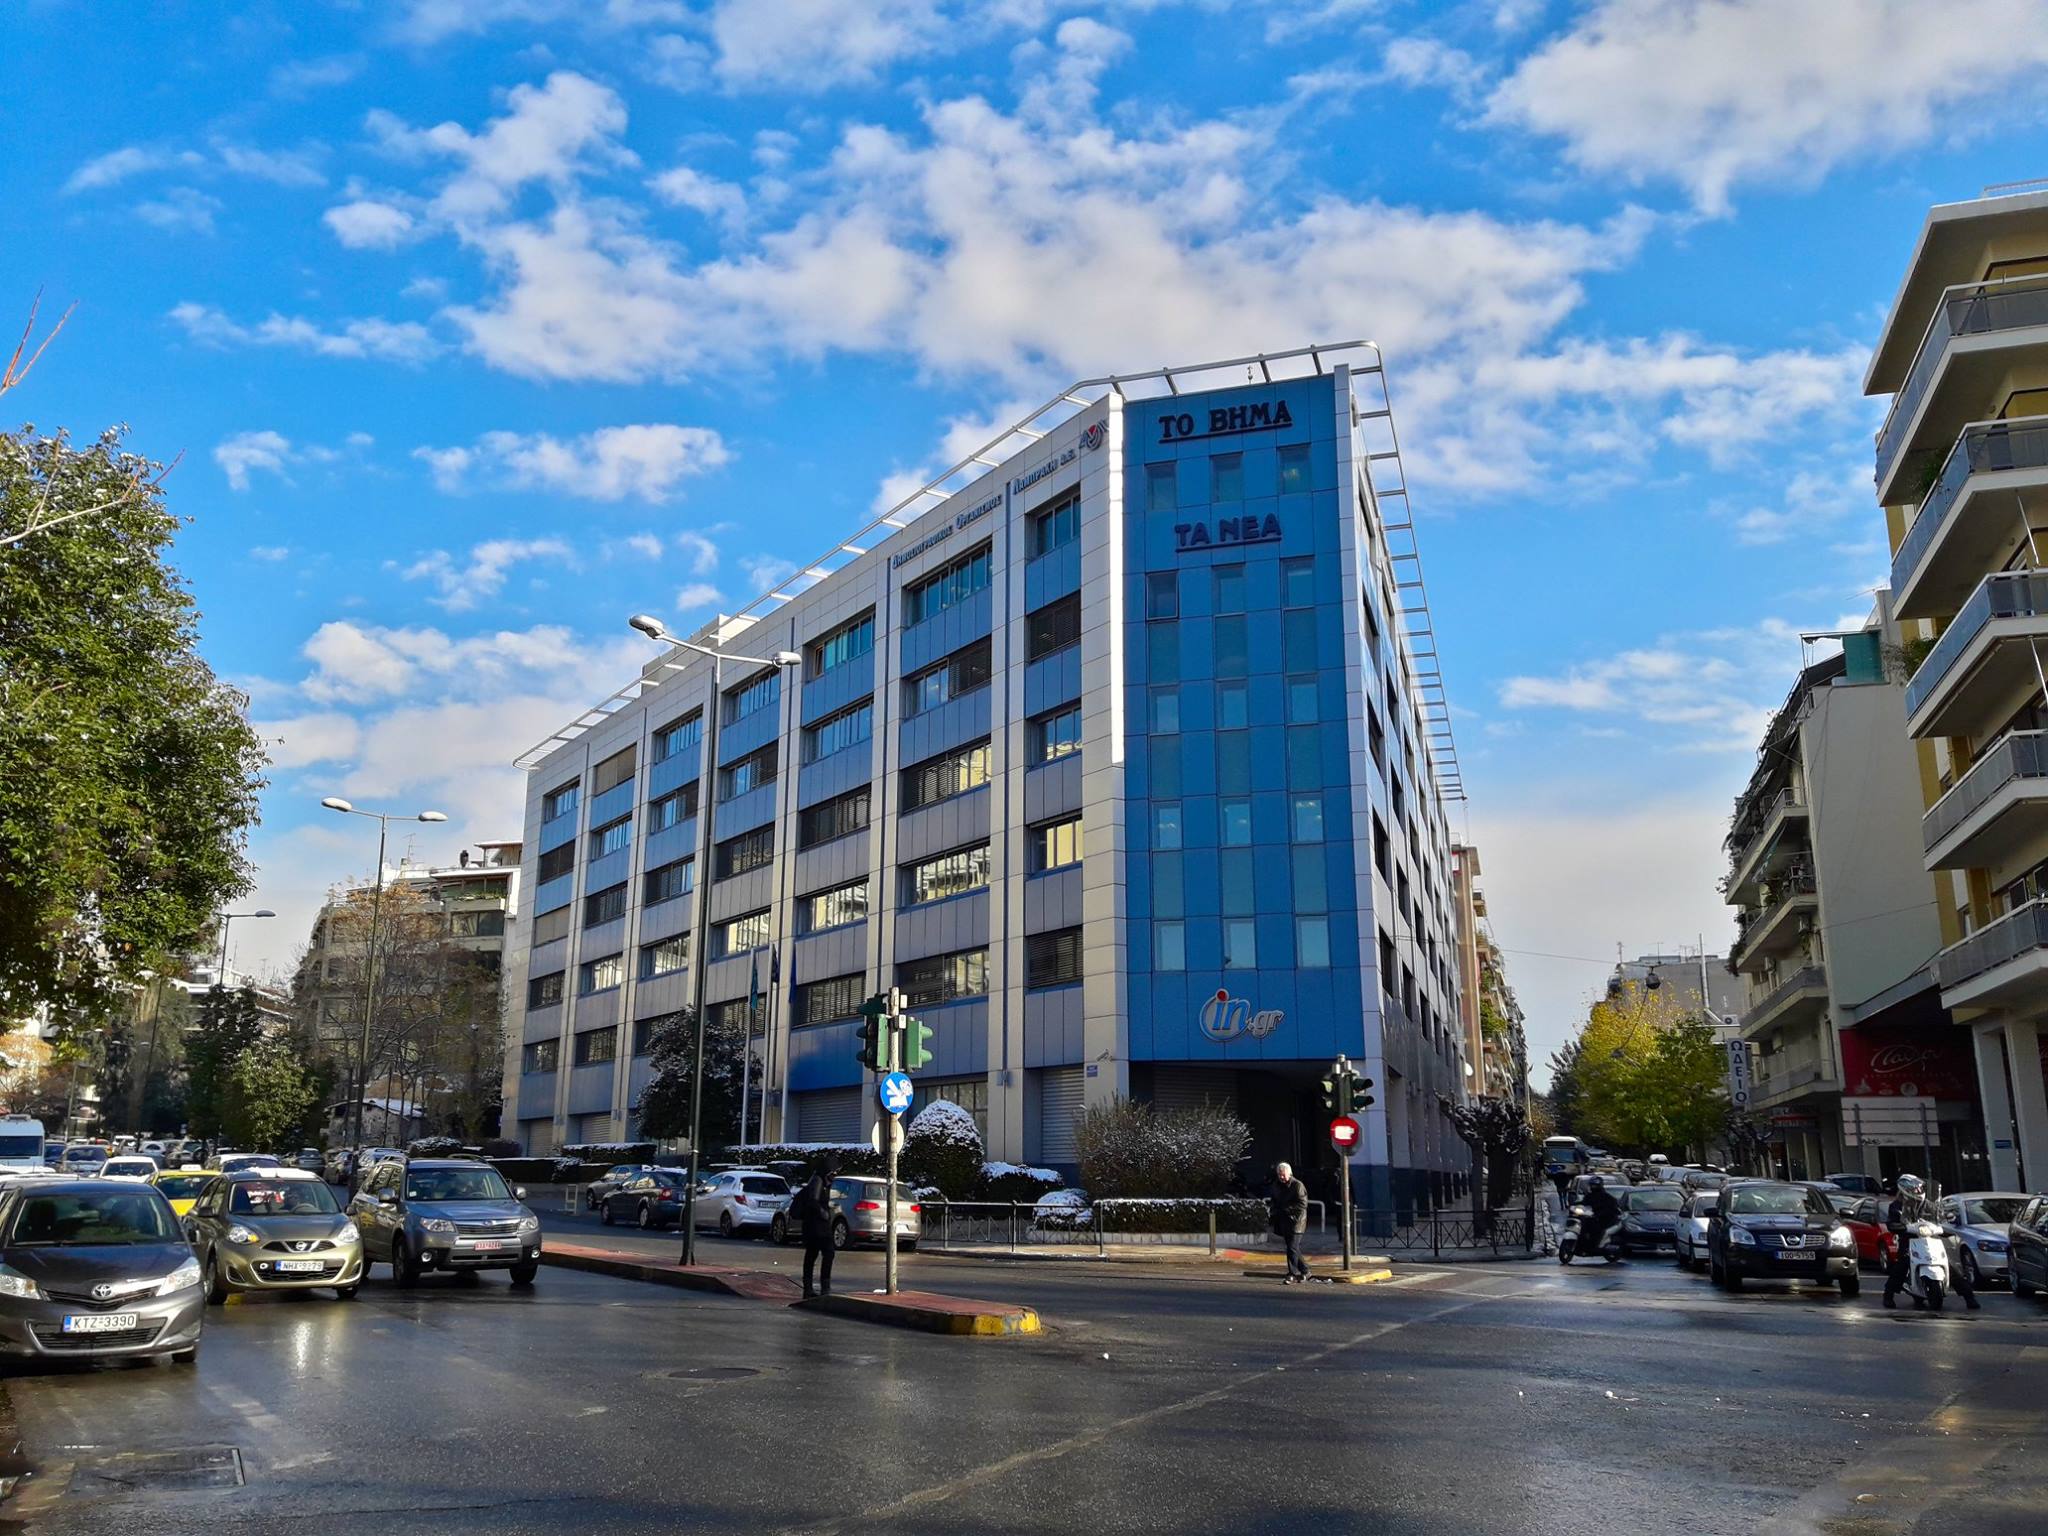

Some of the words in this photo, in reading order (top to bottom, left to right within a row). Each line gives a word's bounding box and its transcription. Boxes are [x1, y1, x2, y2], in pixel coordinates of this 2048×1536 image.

[1158, 413, 1195, 438] ΤΟ
[1209, 400, 1292, 432] ΒΗΜΑ
[1174, 522, 1210, 546] ΤΑ
[1219, 513, 1282, 542] ΝΕΑ
[1200, 988, 1285, 1041] in.gr
[1731, 1041, 1747, 1102] ΩΔΕΙΟ
[74, 1315, 135, 1328] KTZ-3390
